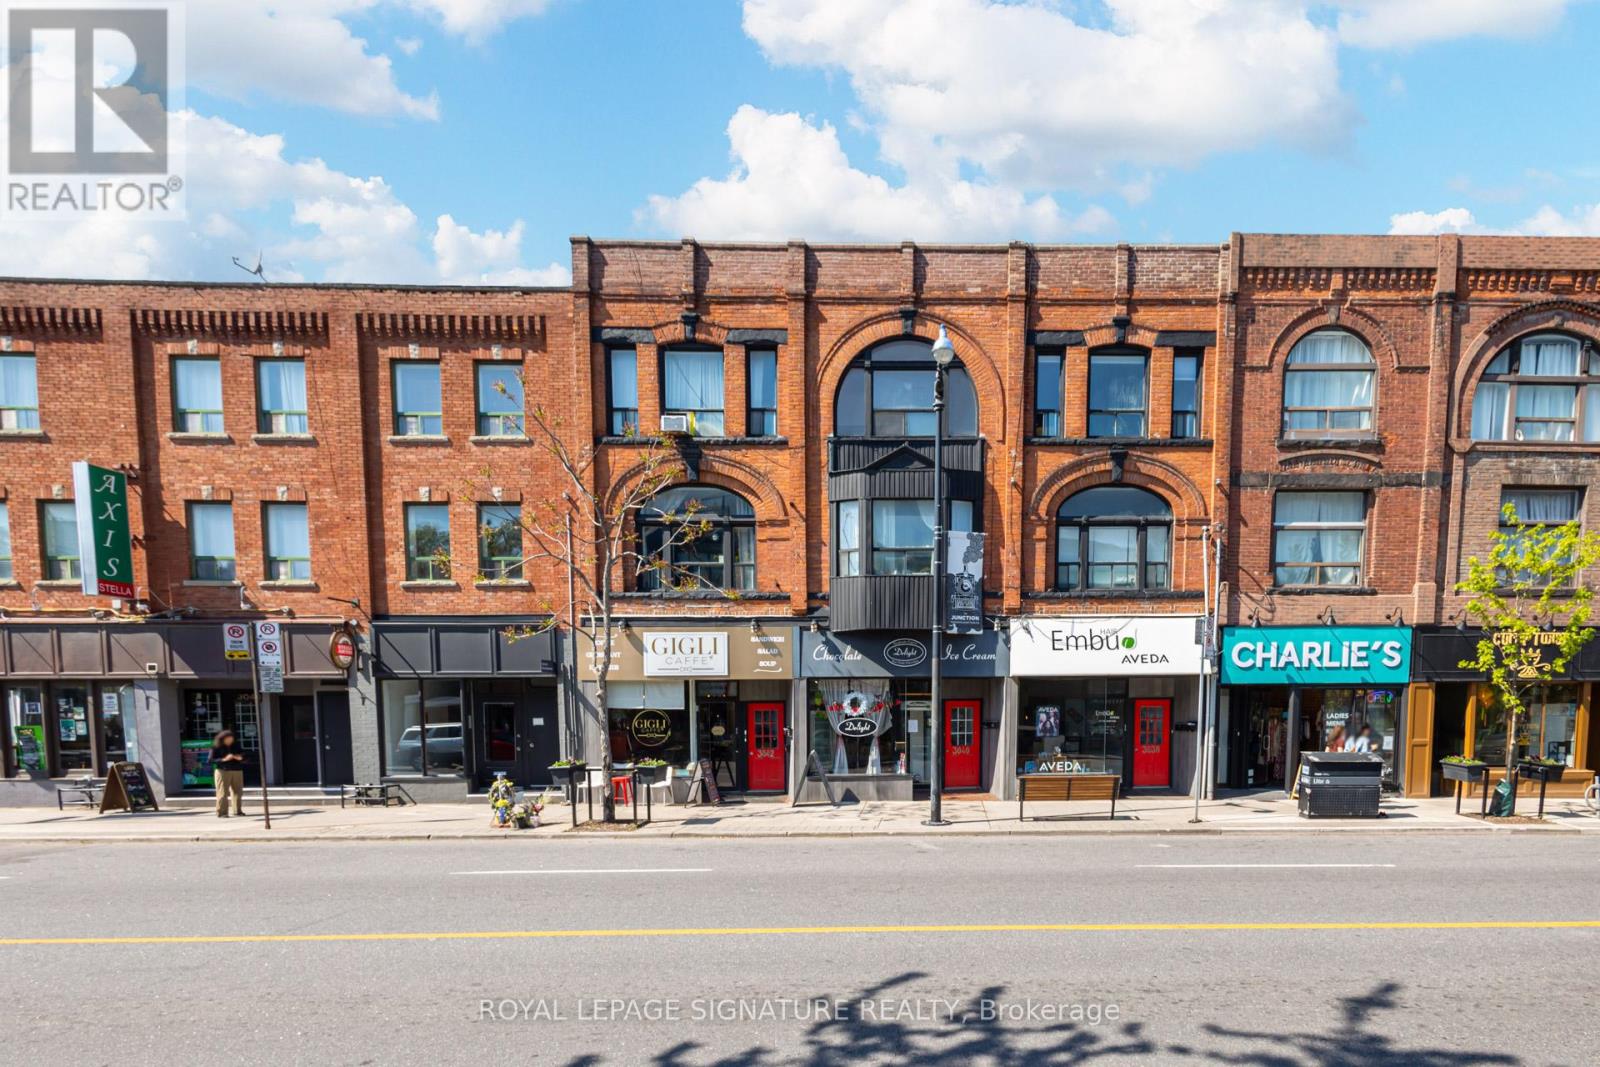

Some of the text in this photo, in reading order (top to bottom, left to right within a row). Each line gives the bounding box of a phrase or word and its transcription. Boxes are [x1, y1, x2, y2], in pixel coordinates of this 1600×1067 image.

[94, 474, 121, 577] AXIS
[100, 583, 132, 596] STELLA
[652, 637, 718, 655] GIGLI
[940, 644, 997, 660] Ice Cream
[813, 644, 862, 661] Chocolate
[893, 647, 917, 658] Delight
[1121, 654, 1170, 664] AVEDA
[635, 719, 666, 729] GIGLI
[845, 721, 871, 733] Delight
[1039, 761, 1081, 772] AVEDA
